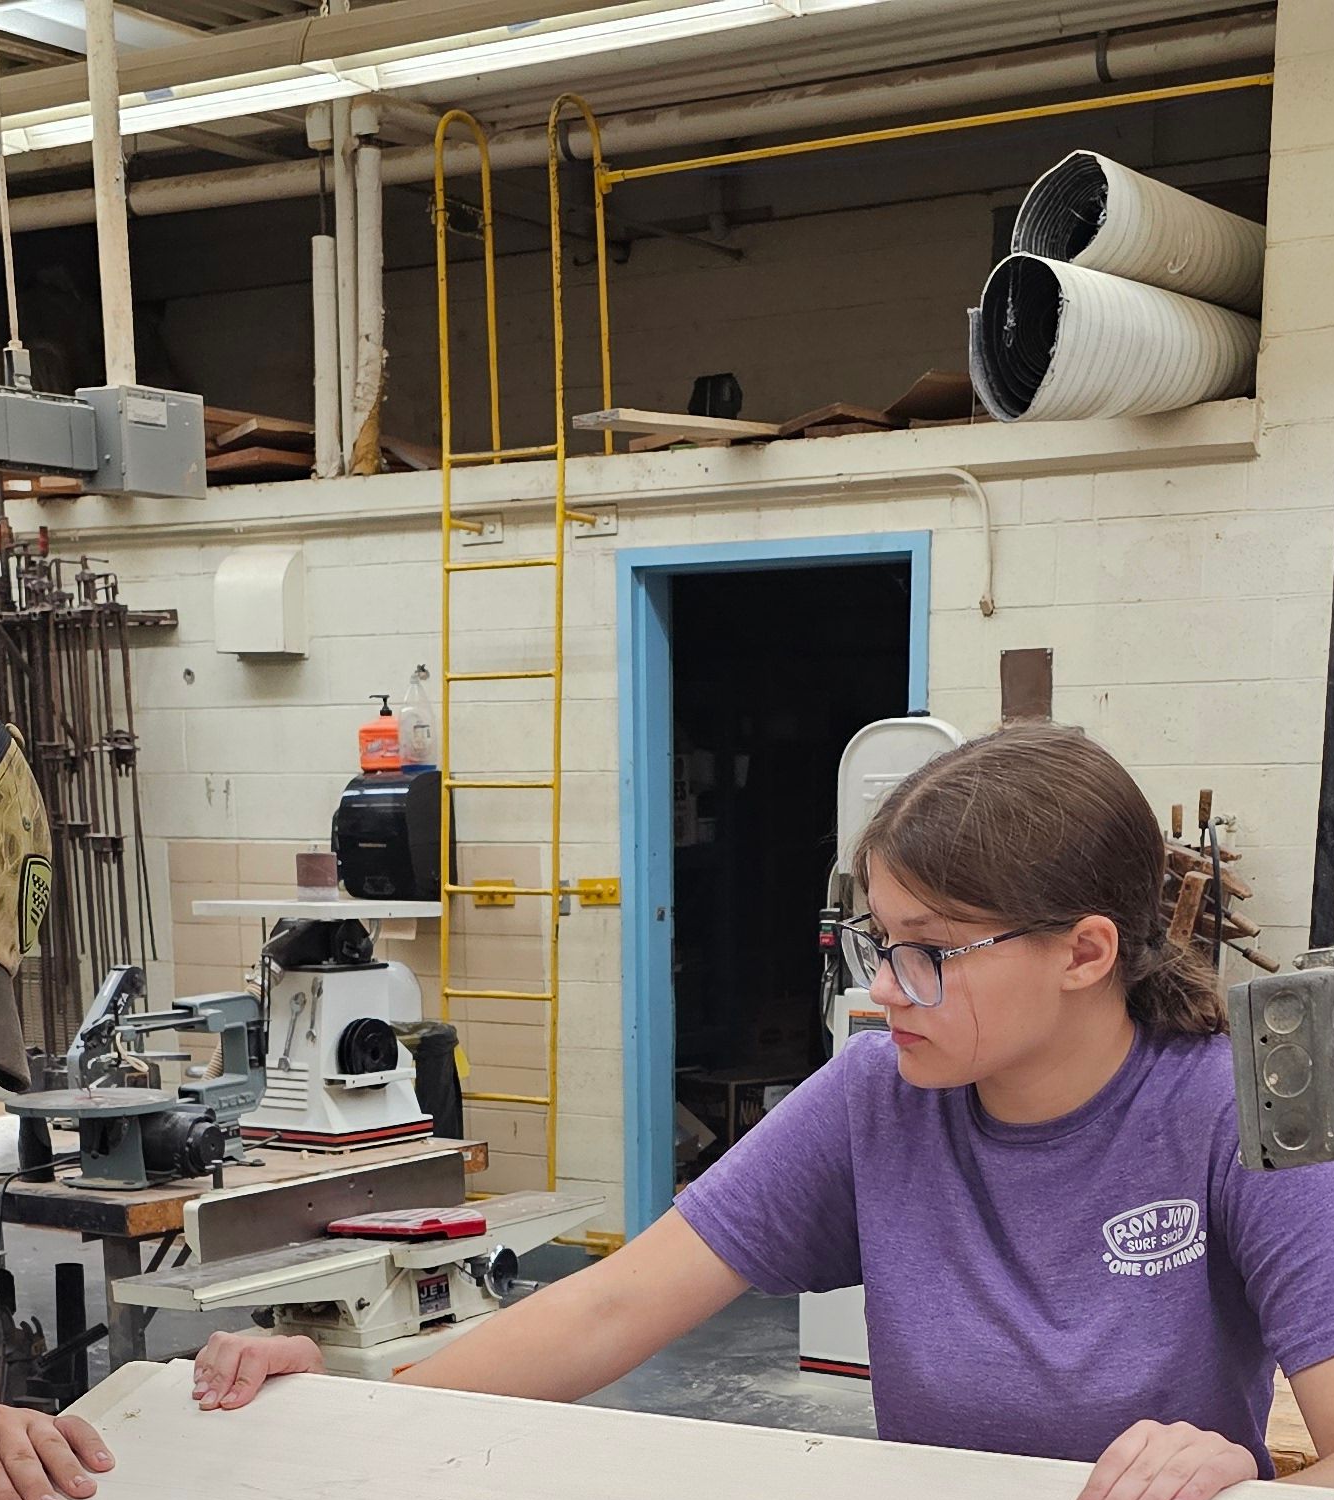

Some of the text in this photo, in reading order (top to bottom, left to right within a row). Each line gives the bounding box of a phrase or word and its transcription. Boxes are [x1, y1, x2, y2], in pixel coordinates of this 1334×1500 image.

[1113, 1206, 1192, 1246] RON JON
[1127, 1227, 1184, 1253] SURF SHOP
[1108, 1242, 1206, 1277] ONE OF A KIND
[420, 1281, 448, 1299] JET
